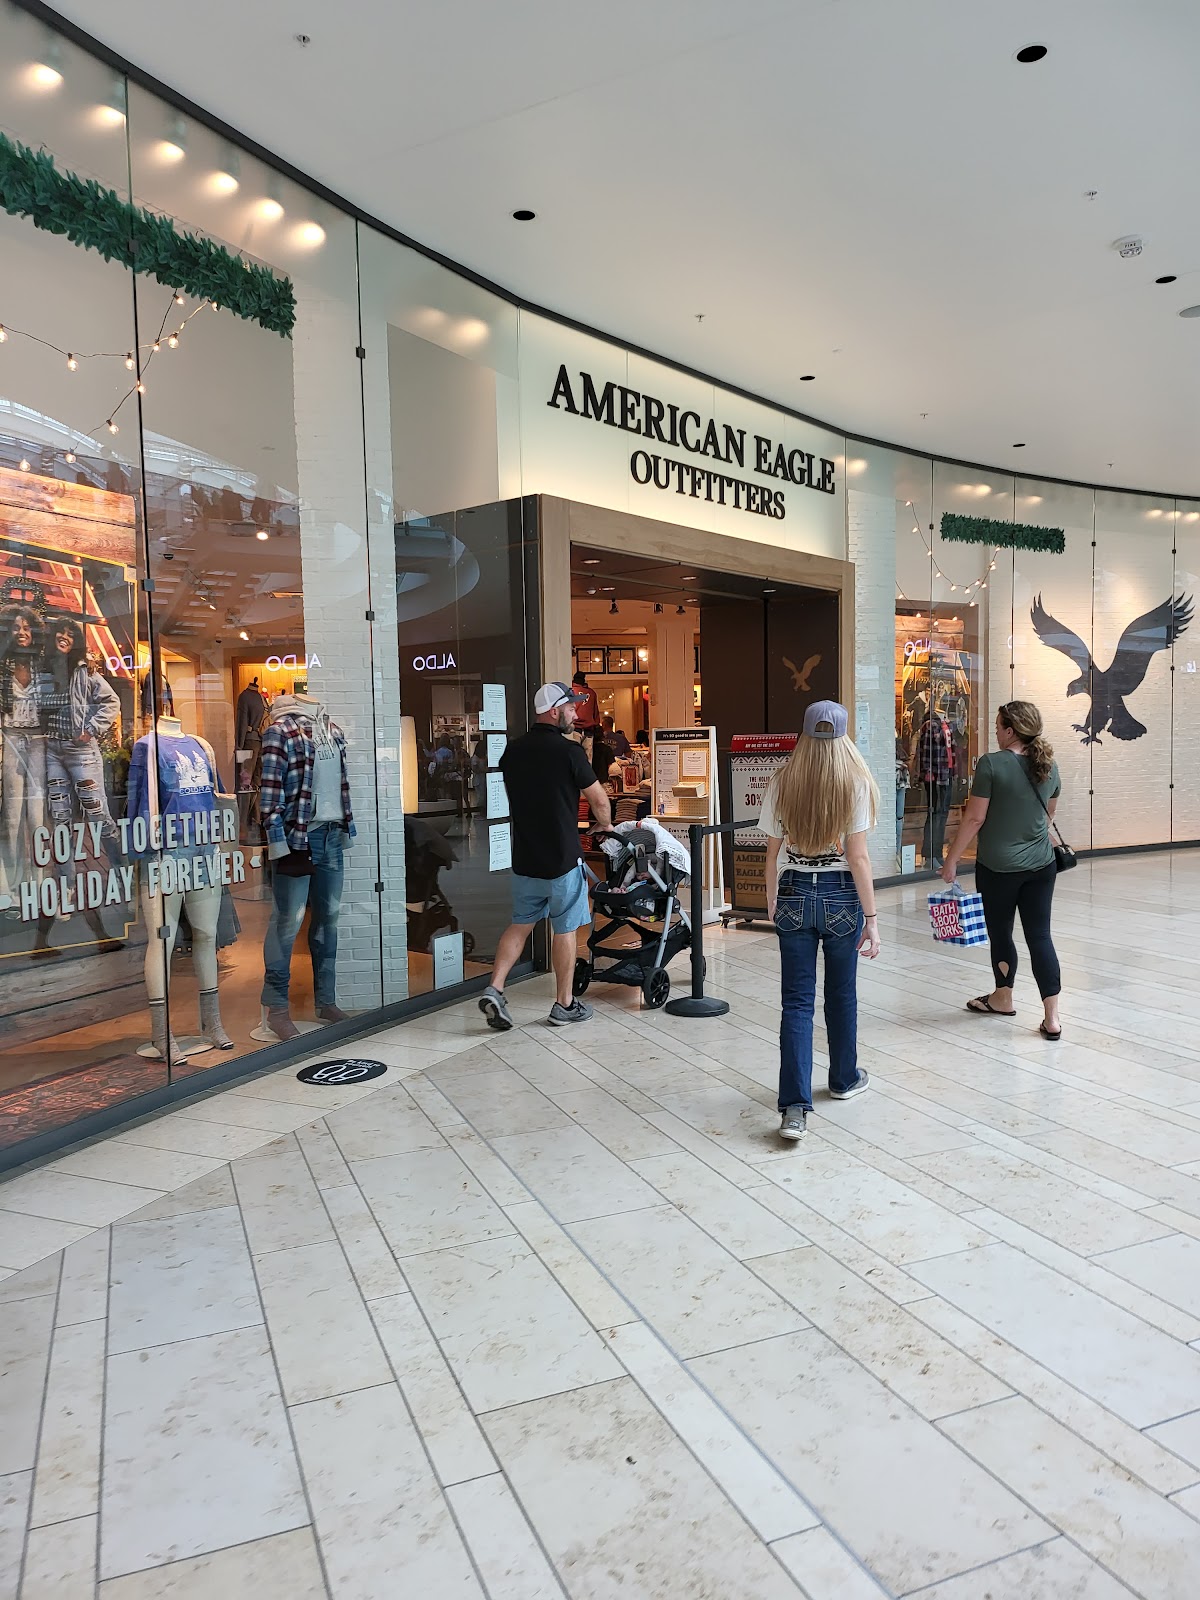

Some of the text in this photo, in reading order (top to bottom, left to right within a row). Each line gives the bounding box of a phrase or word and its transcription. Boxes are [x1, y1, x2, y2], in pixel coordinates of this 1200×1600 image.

[547, 364, 836, 495] AMERICAN EAGLE
[630, 450, 786, 520] OUTFITTERS
[33, 808, 237, 867] COZY TOGETHER
[735, 854, 767, 863] AMERI
[736, 868, 764, 877] EAGLE
[20, 850, 246, 922] HOLIDAY FOREVER
[932, 902, 956, 918] BATH
[932, 911, 960, 928] & BODY
[934, 922, 965, 939] WORKS
